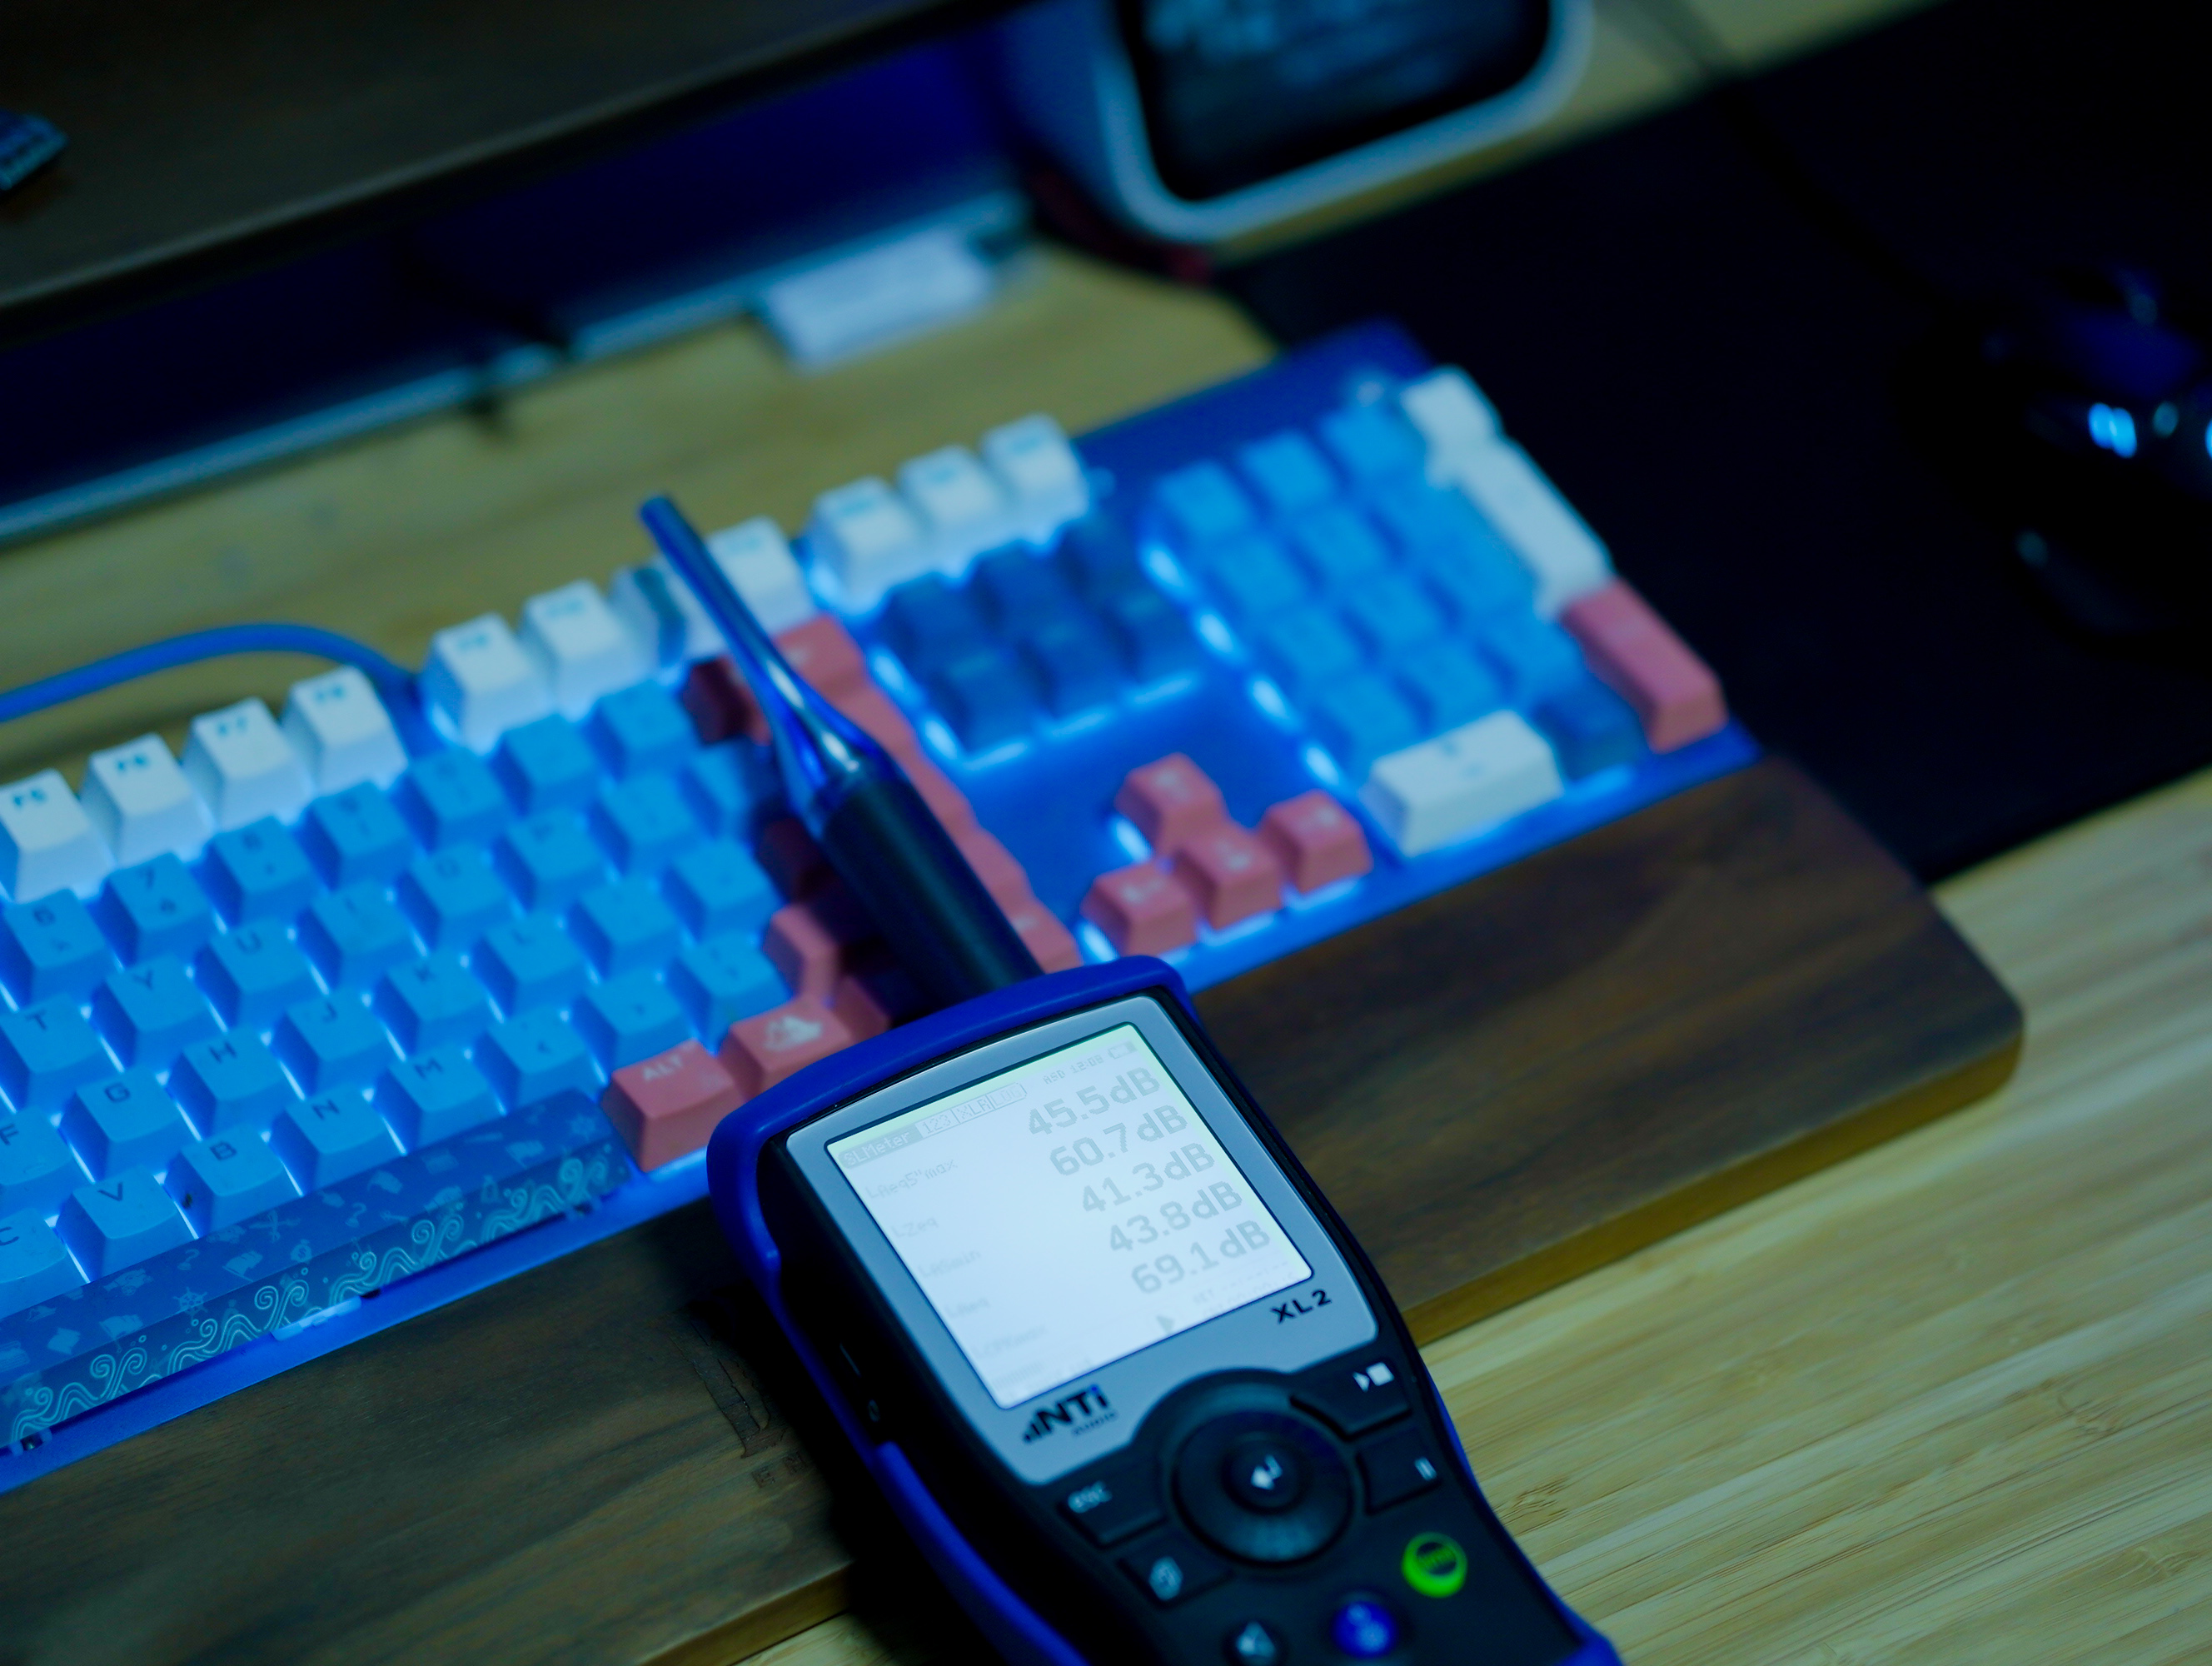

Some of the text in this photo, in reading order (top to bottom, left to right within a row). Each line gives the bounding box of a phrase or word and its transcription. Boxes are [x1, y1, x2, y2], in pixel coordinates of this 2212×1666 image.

[208, 1040, 237, 1065] H
[103, 1082, 132, 1104] G
[1029, 1067, 1160, 1135] 45.5dB
[922, 1114, 952, 1135] 123
[957, 1098, 992, 1120] XLR
[209, 1138, 238, 1161] B
[1049, 1105, 1188, 1176] 60.7dB
[97, 1181, 125, 1203] V
[1083, 1142, 1215, 1212] 41.3dB
[1109, 1180, 1243, 1252] 43.8dB
[1131, 1220, 1270, 1294] 69.1dB
[1268, 1287, 1333, 1325] XL2
